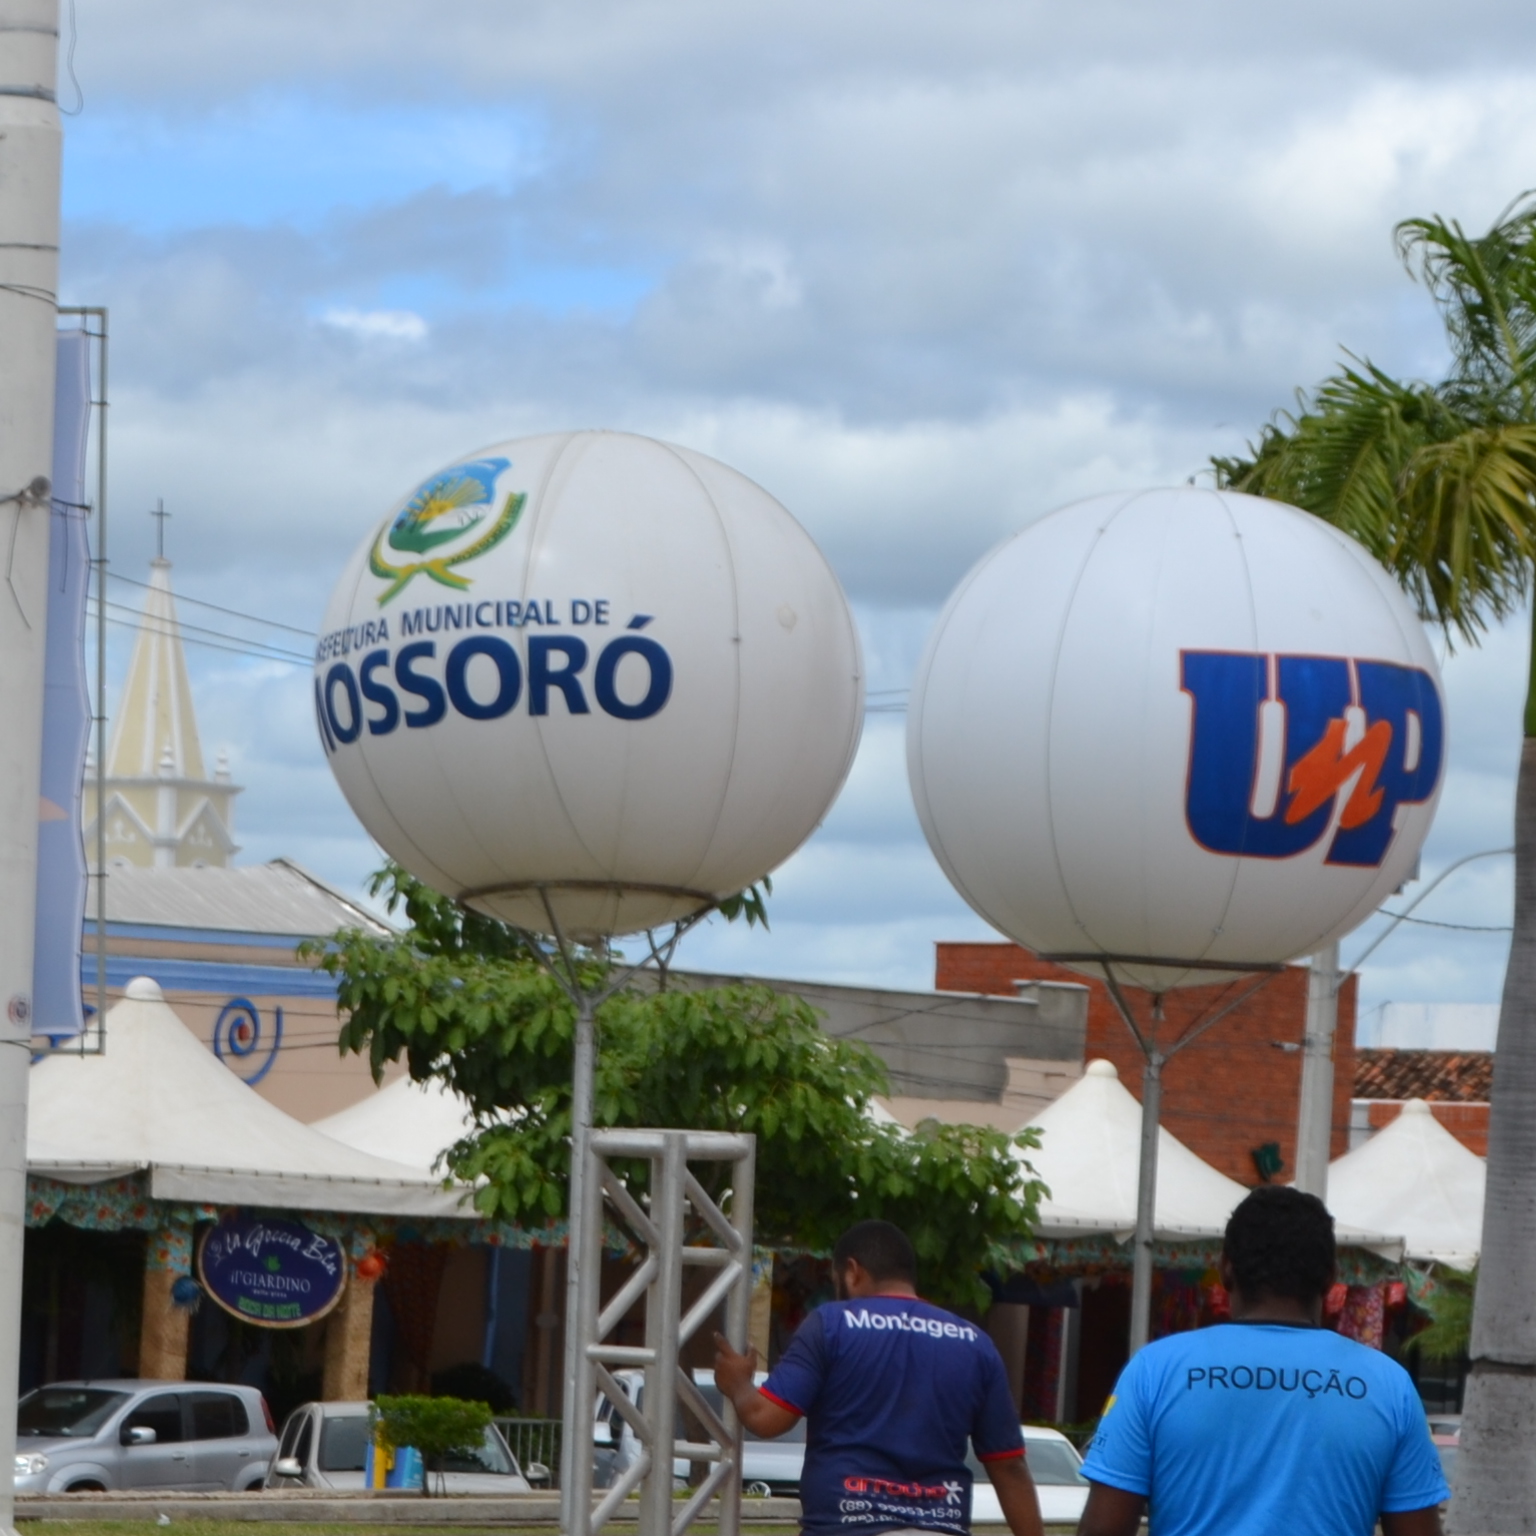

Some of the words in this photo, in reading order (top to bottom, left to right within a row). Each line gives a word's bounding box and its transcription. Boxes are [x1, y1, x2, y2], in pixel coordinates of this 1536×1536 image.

[316, 618, 390, 663] REFEITURA
[401, 600, 560, 637] MUNICIPAL
[570, 599, 610, 626] DE
[1186, 1365, 1368, 1400] PRODUÇÃO
